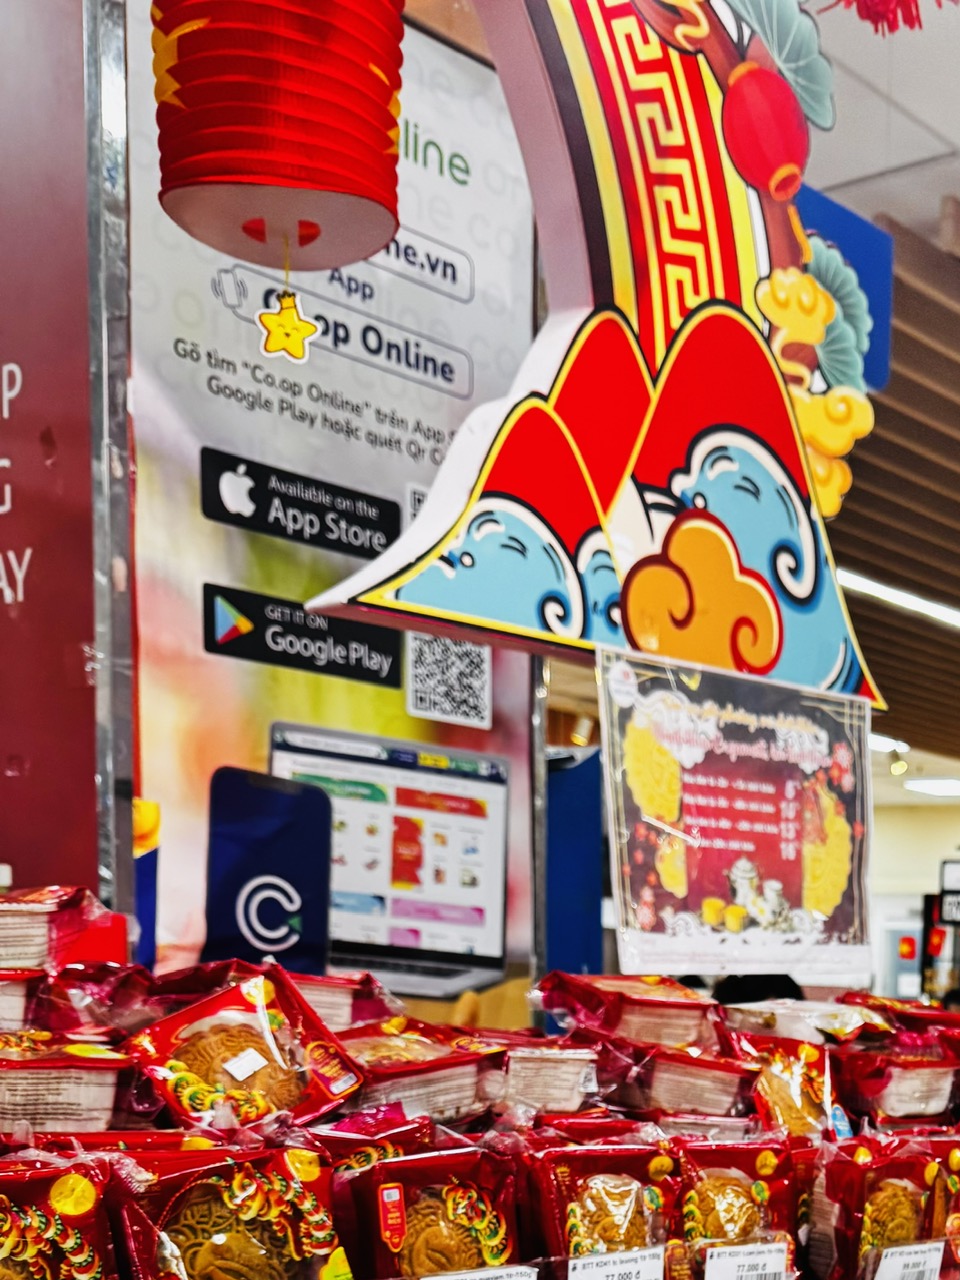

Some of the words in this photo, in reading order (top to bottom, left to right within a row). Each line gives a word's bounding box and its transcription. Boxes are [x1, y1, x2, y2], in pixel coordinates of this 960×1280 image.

[403, 118, 472, 187] line
[329, 268, 375, 302] App
[361, 325, 456, 384] Online
[206, 348, 237, 375] tìm
[412, 418, 446, 445] App
[206, 374, 274, 412] Google
[277, 397, 318, 430] Play
[267, 474, 333, 510] Available
[334, 496, 354, 512] on
[355, 499, 380, 521] the
[267, 496, 320, 540] App
[324, 511, 388, 554] Store
[264, 603, 291, 622] GET
[264, 624, 347, 667] Google
[348, 639, 394, 678] Play
